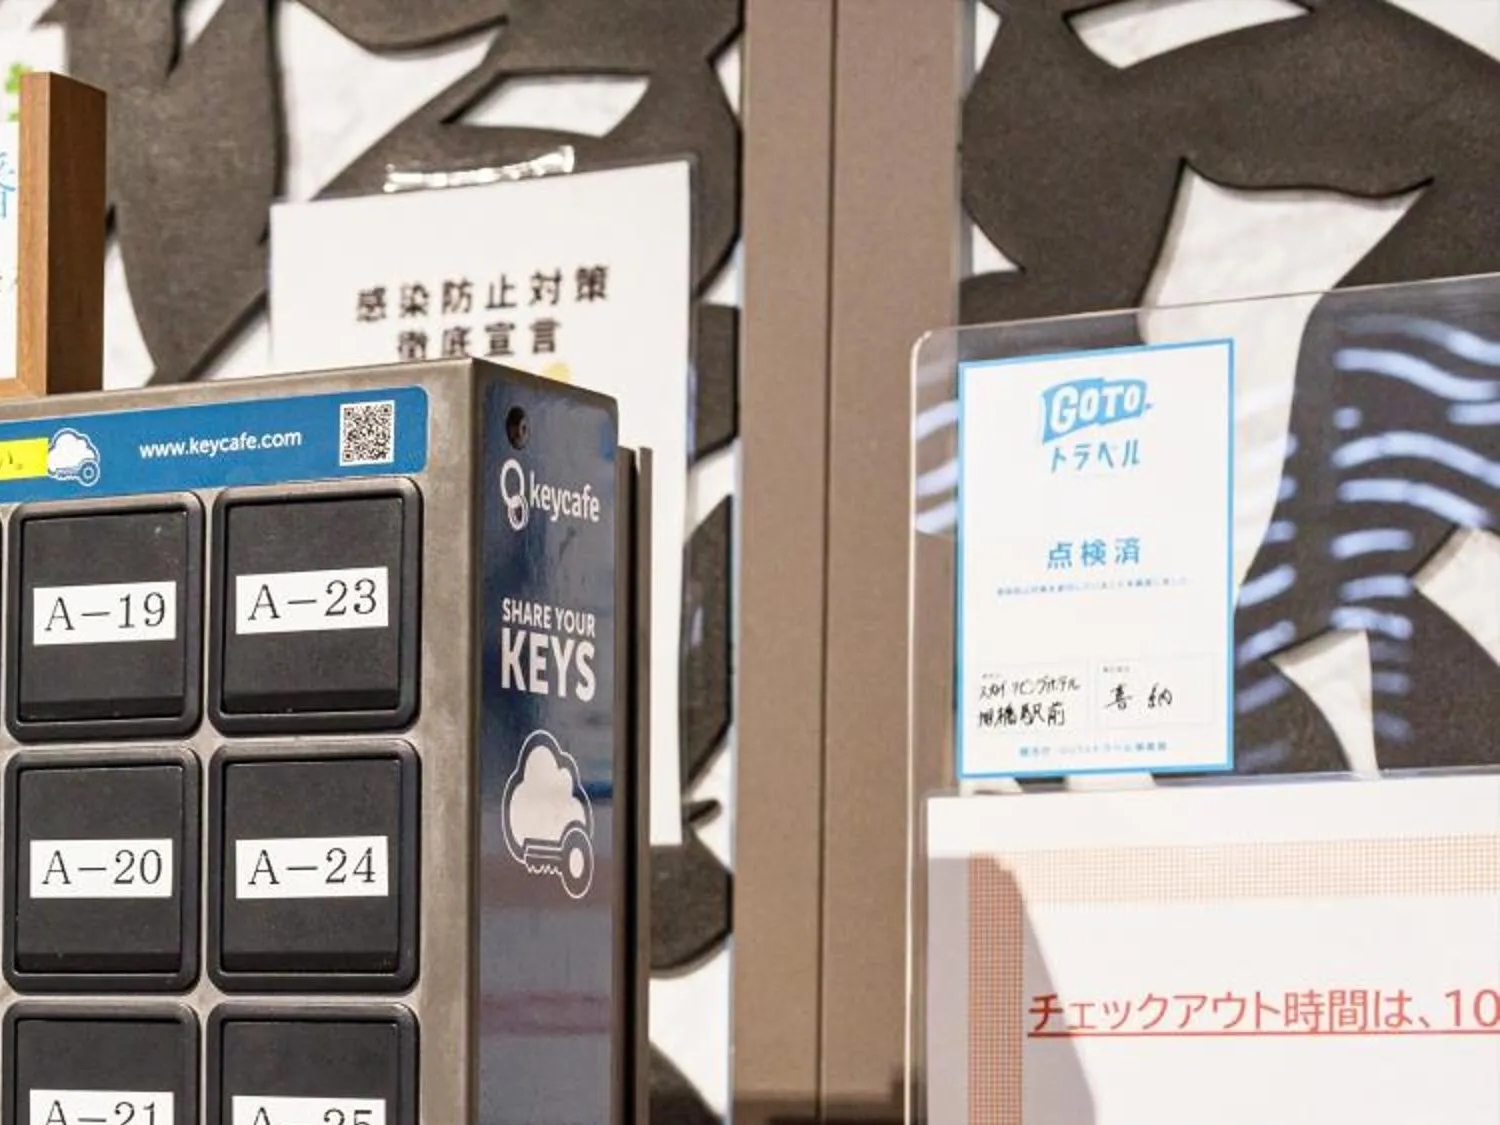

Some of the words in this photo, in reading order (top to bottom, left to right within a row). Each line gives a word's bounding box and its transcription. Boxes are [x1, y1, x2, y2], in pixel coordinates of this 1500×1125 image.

[357, 264, 609, 322] 感染防止対策
[397, 317, 561, 360] 徹底宣言
[139, 430, 303, 460] www.keycafe.com
[529, 470, 600, 523] keycafe
[1047, 537, 1140, 569] 点検済
[45, 592, 165, 631] A-19
[248, 579, 377, 621] A-23
[502, 597, 552, 630] SHARE
[555, 607, 596, 638] YOUR
[501, 627, 596, 702] KEYS
[42, 849, 162, 885] A-20
[248, 847, 375, 885] A-24
